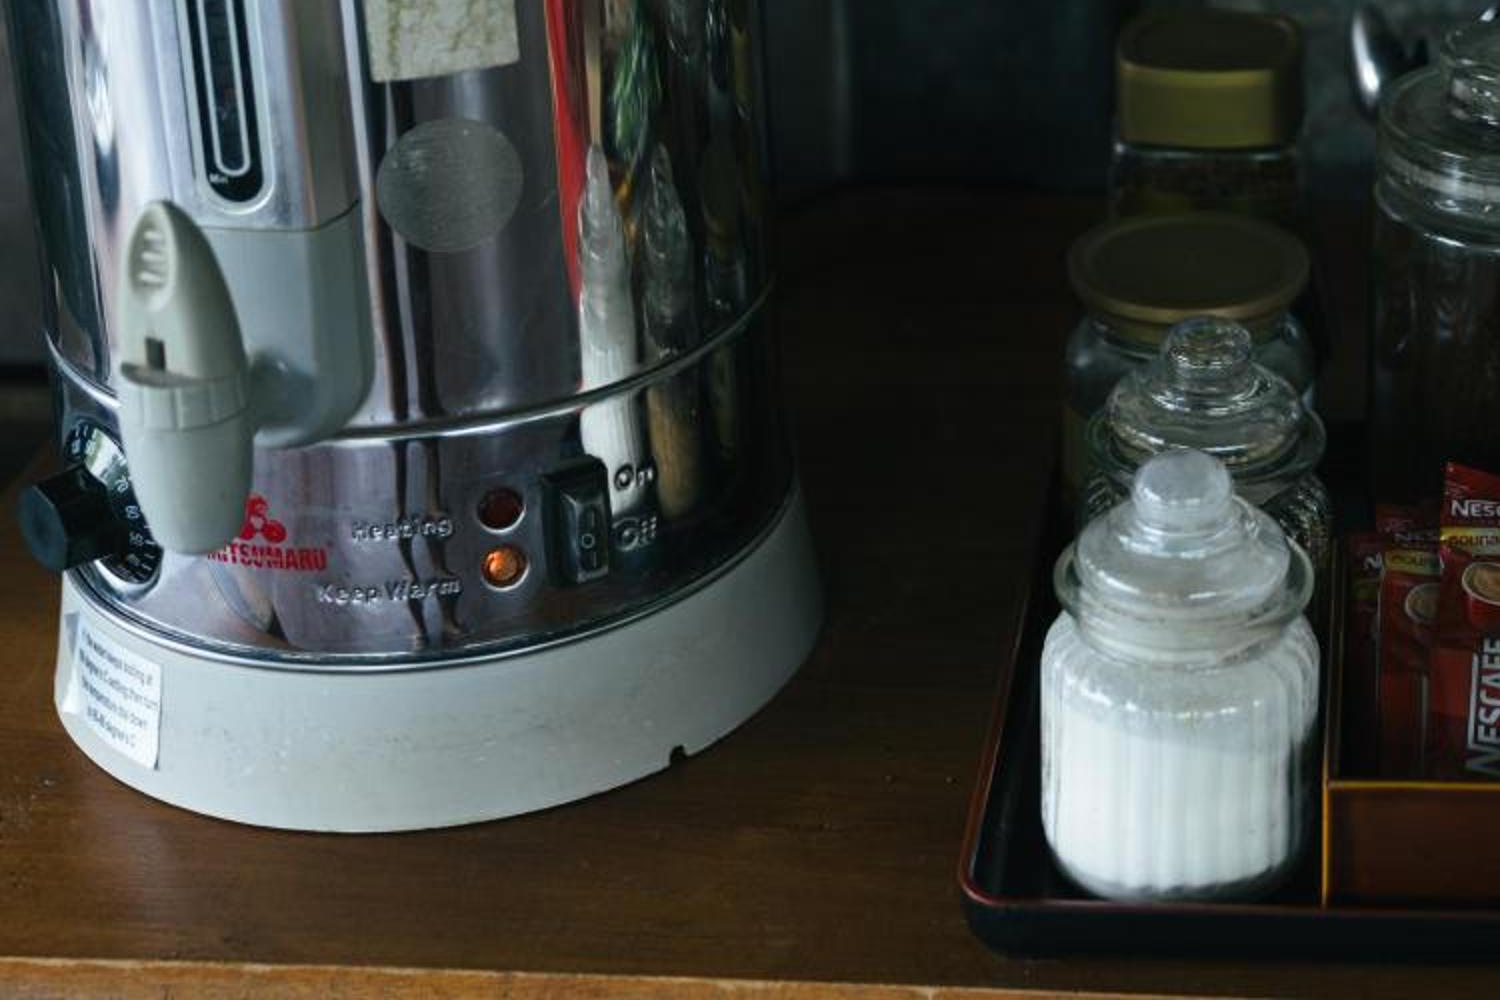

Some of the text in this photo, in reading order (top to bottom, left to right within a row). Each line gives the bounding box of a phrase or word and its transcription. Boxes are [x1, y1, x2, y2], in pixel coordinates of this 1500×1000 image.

[351, 516, 454, 542] Heating
[317, 577, 463, 606] Keep Warm
